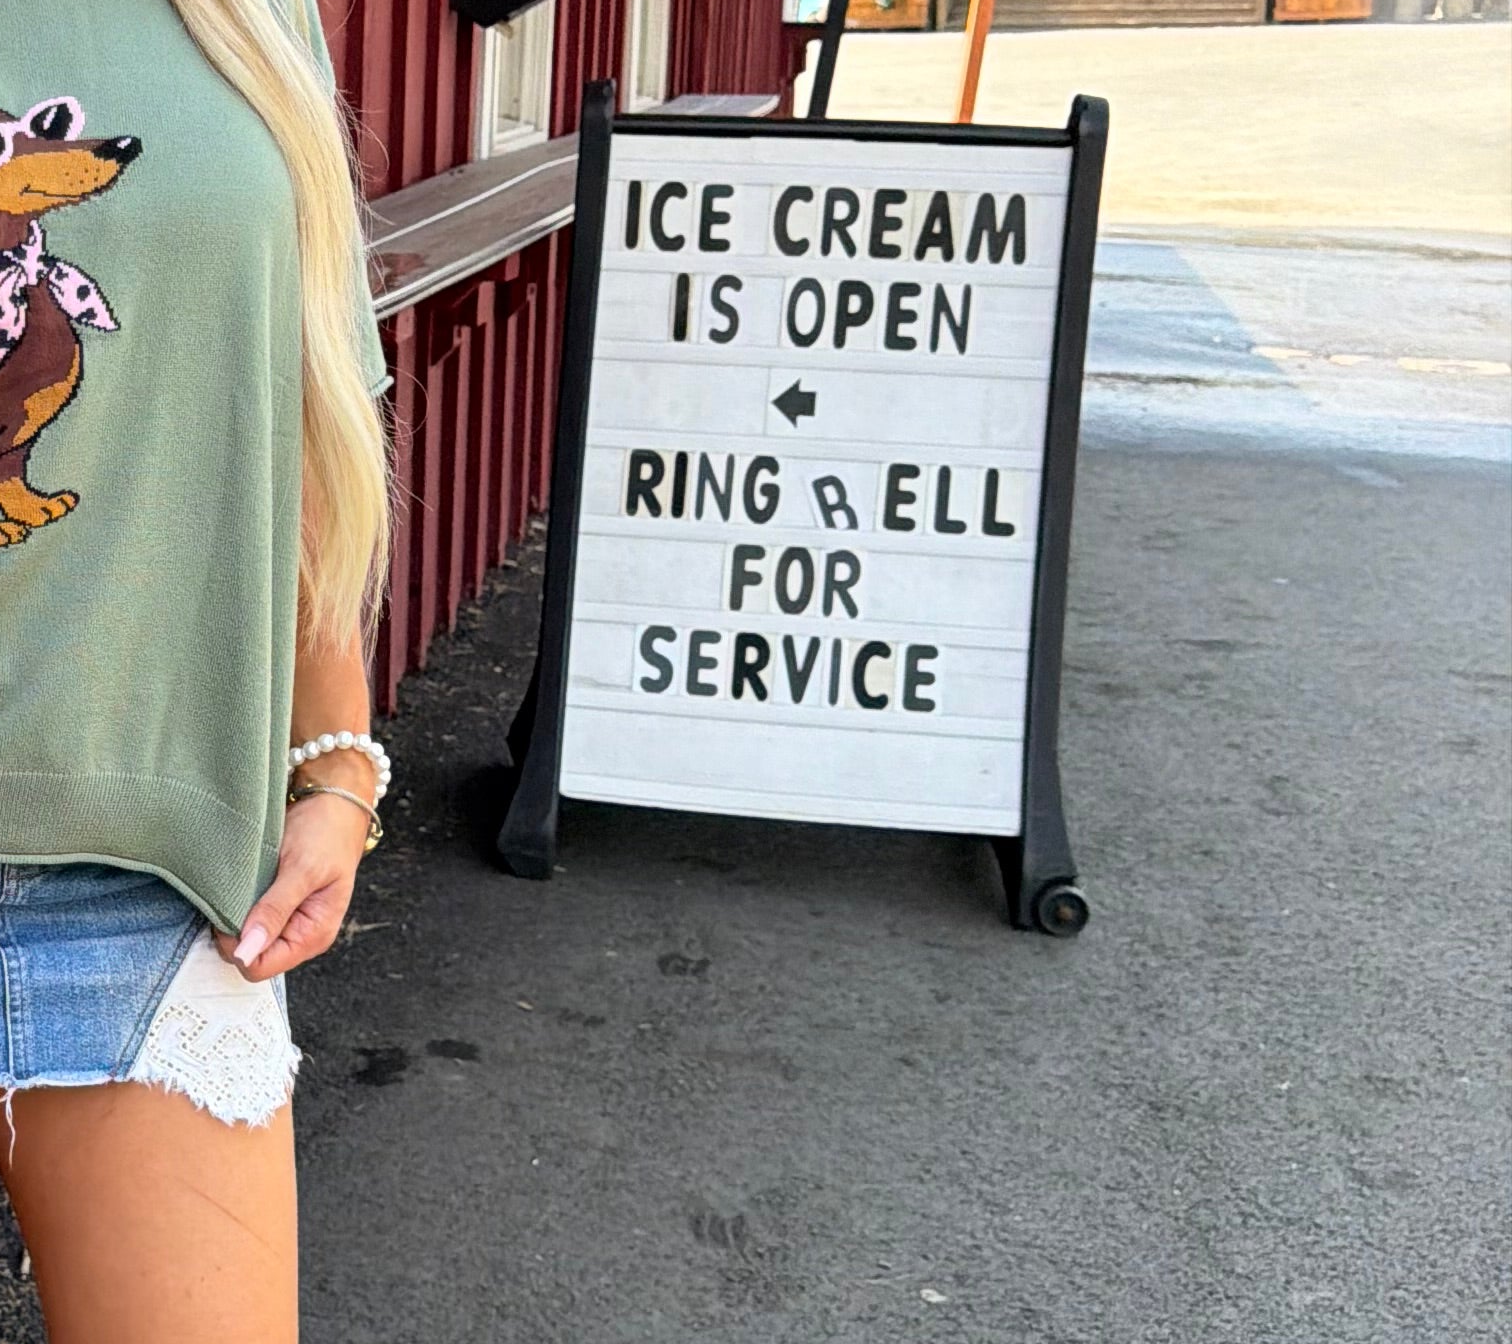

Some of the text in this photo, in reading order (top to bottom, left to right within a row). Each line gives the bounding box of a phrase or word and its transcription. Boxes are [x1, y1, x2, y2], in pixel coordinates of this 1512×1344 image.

[624, 180, 1027, 265] ICE CREAM
[672, 272, 972, 355] IS OPEN
[625, 448, 781, 525] RING
[729, 544, 862, 619] FOR
[638, 625, 939, 713] SERVICE
